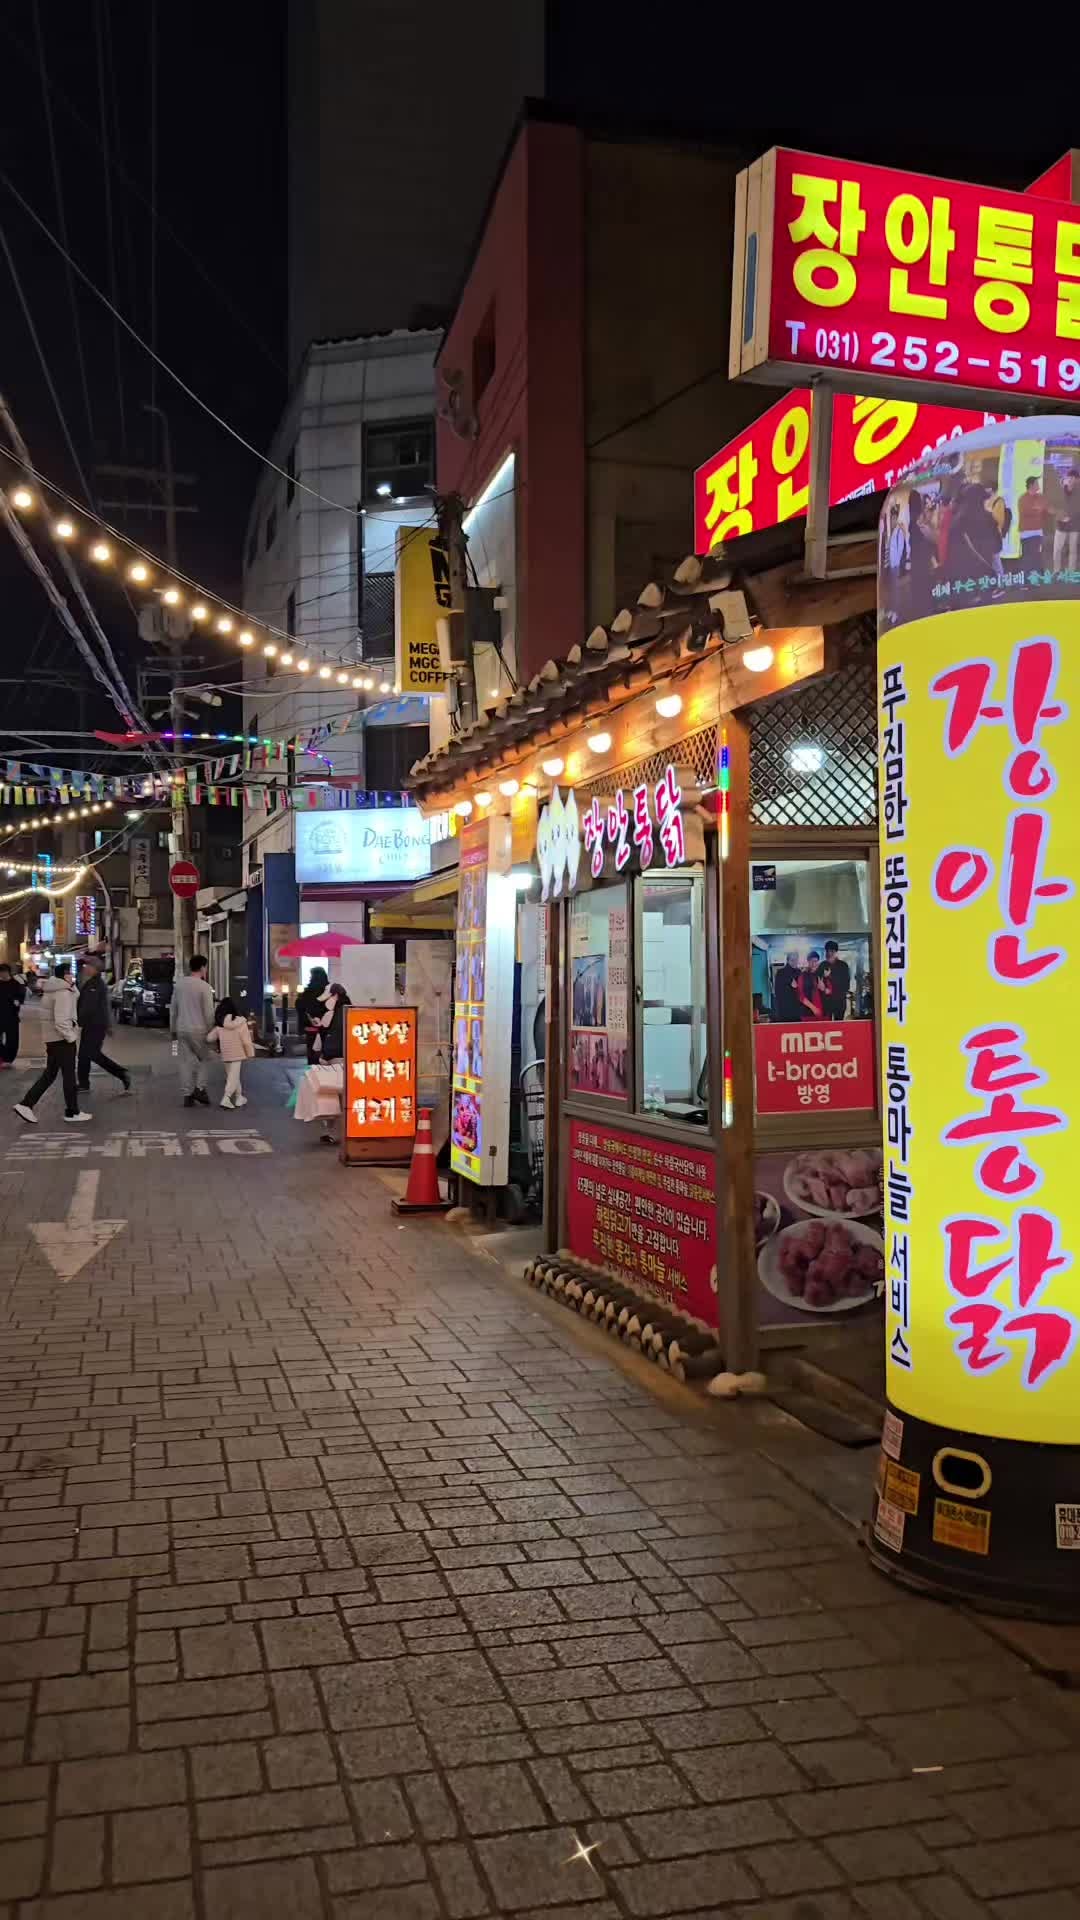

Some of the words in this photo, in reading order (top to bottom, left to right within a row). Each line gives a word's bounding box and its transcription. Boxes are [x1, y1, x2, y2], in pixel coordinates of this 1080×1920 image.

[785, 319, 806, 355] T
[815, 327, 859, 364] 031)
[409, 642, 440, 655] MEG
[409, 656, 440, 669] MGC
[882, 665, 908, 839] 푸짐한
[583, 764, 685, 878] 장안통닭
[884, 856, 909, 1022] 똥집과
[351, 1021, 410, 1045] 안창살
[781, 1030, 843, 1053] MBC
[767, 1057, 859, 1082] t-broad
[797, 1084, 831, 1105] 방영
[886, 1045, 912, 1222] 통마늘
[639, 1249, 666, 1285] 통마늘
[667, 1268, 689, 1293] 서비스
[891, 1234, 912, 1370] 서비스
